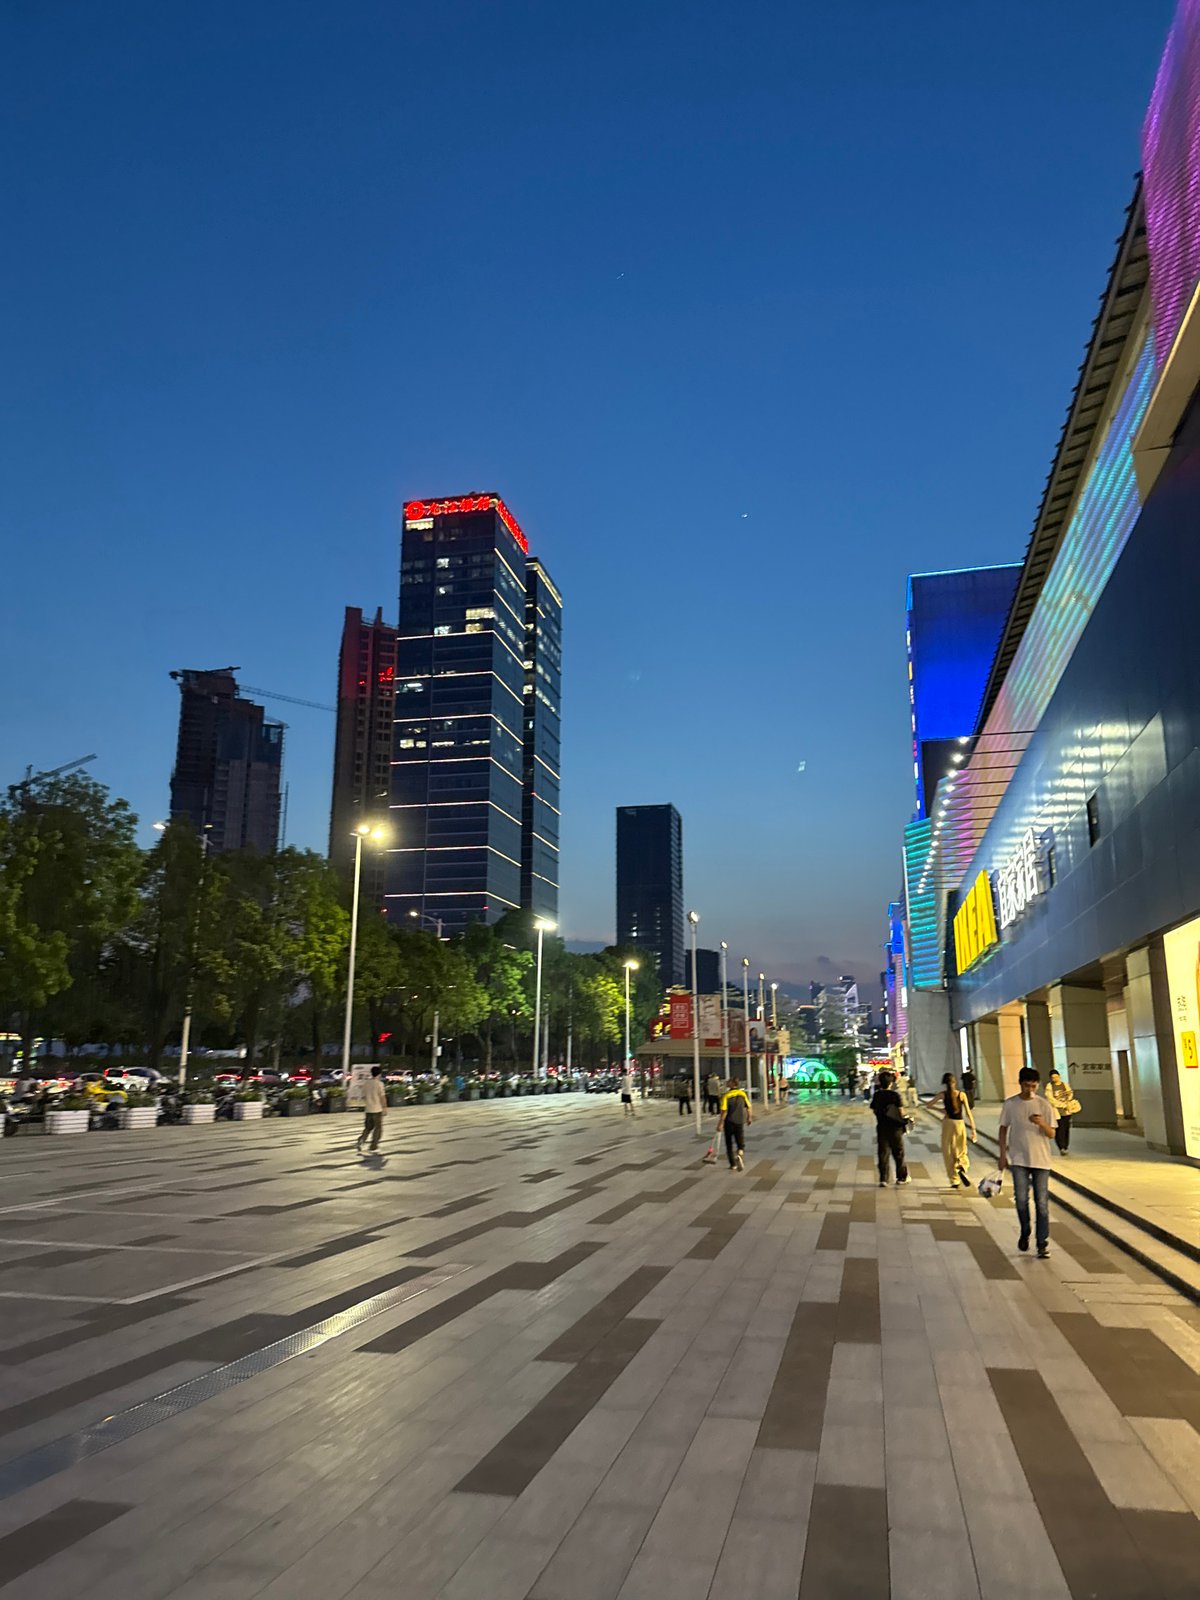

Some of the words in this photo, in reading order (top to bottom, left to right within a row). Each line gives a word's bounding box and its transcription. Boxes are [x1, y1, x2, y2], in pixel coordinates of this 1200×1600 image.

[953, 869, 997, 976] IKEA
[997, 827, 1038, 930] 宜家家居
